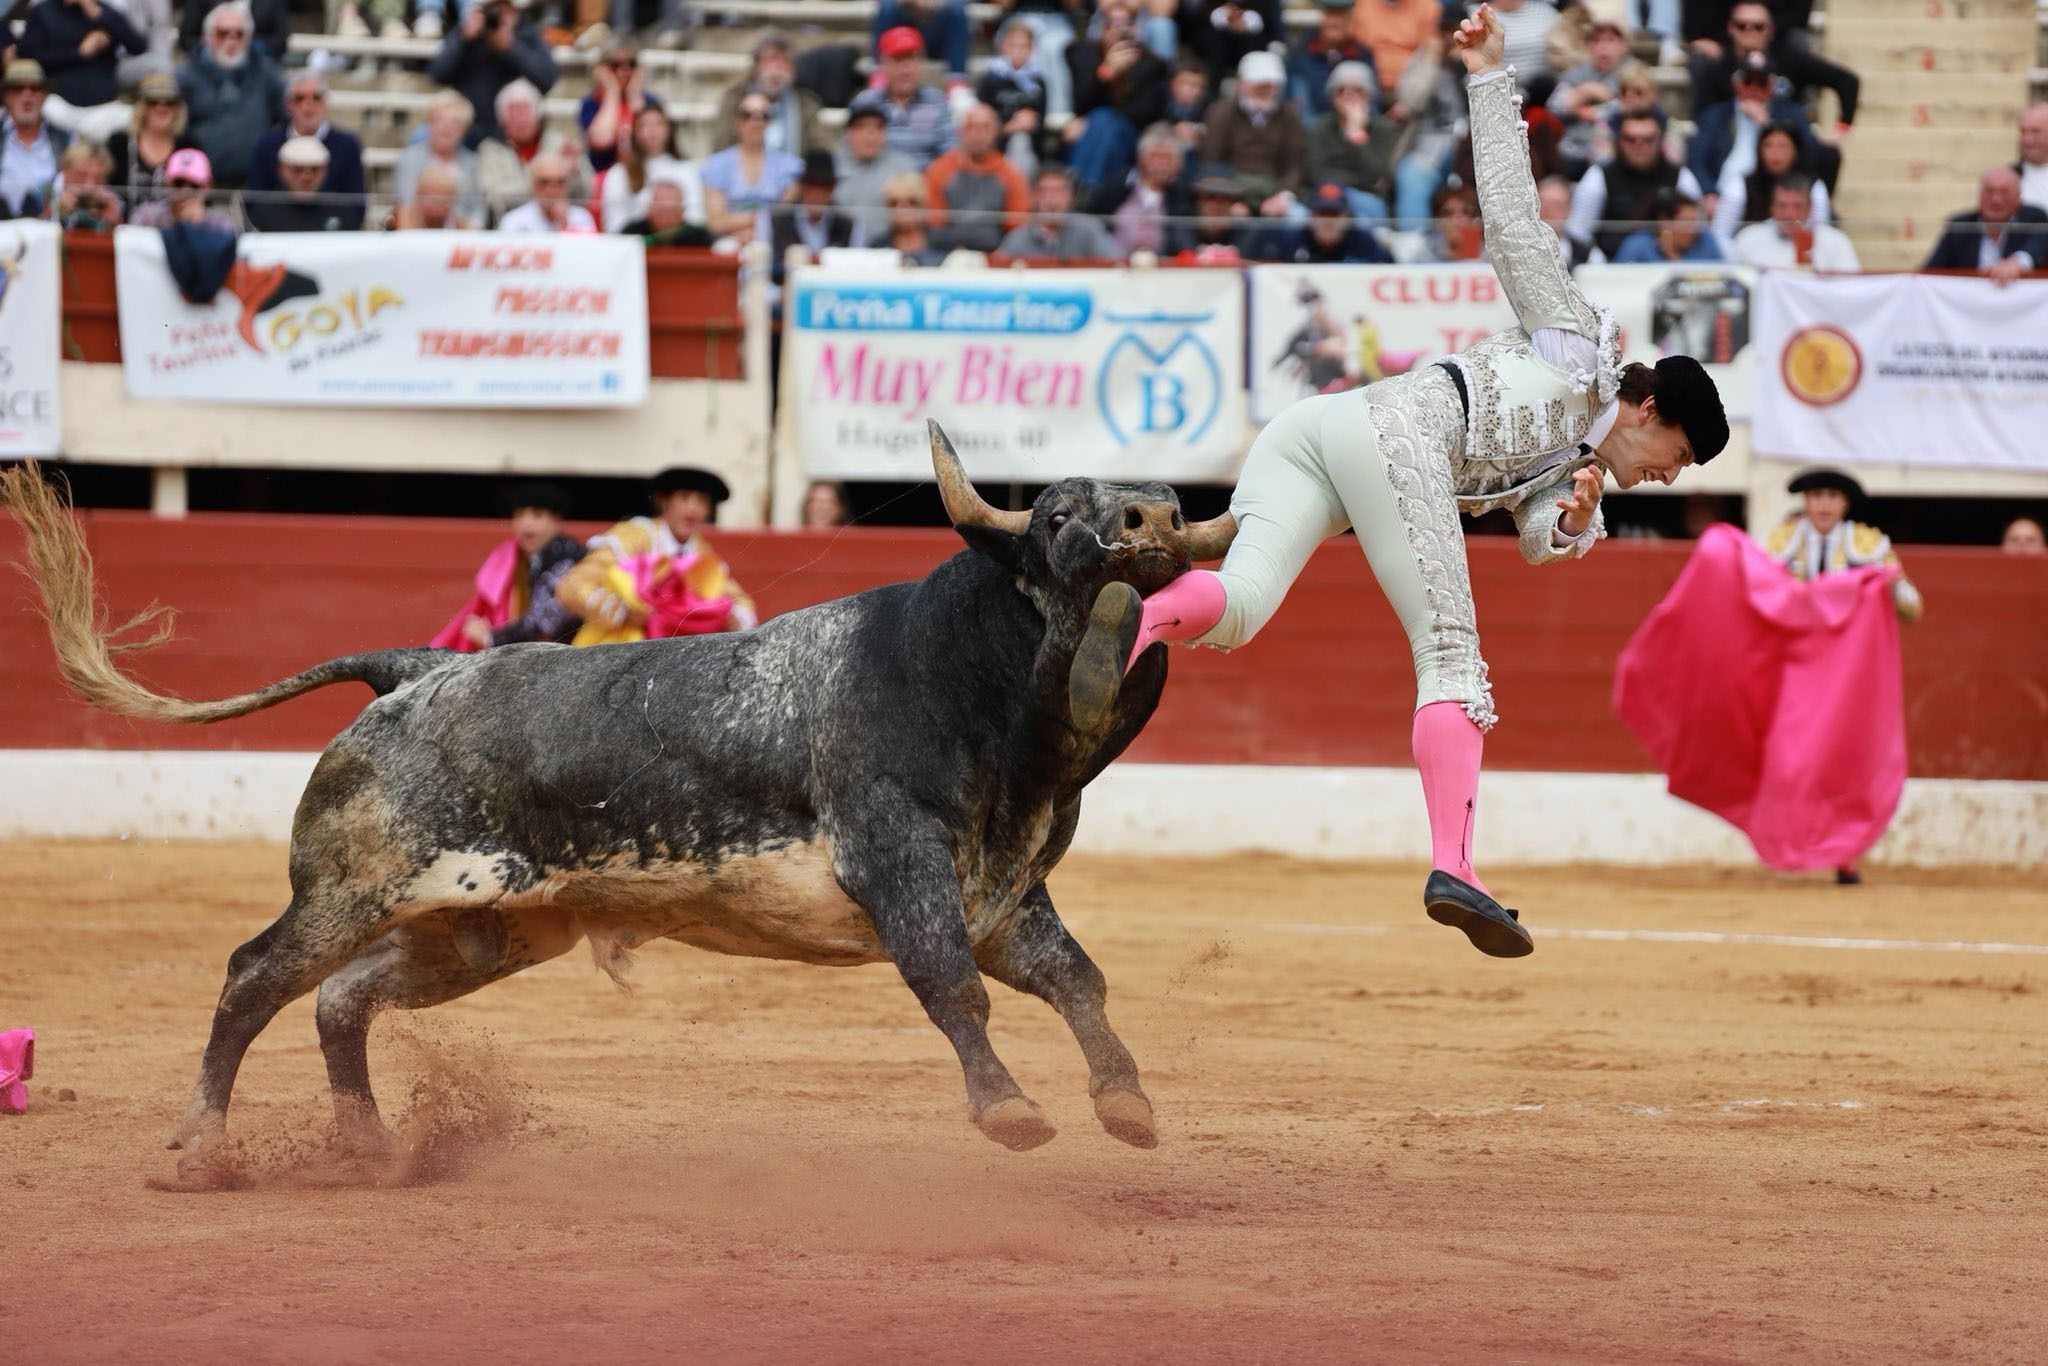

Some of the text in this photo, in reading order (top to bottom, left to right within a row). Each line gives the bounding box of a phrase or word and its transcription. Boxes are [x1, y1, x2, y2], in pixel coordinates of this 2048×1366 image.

[809, 291, 1086, 331] Peña Taurine
[1369, 273, 1498, 304] CLUB
[268, 286, 406, 352] GOYA
[419, 330, 622, 358] TRANSMISSION
[811, 342, 1084, 420] Muy Bien
[1138, 373, 1187, 432] B
